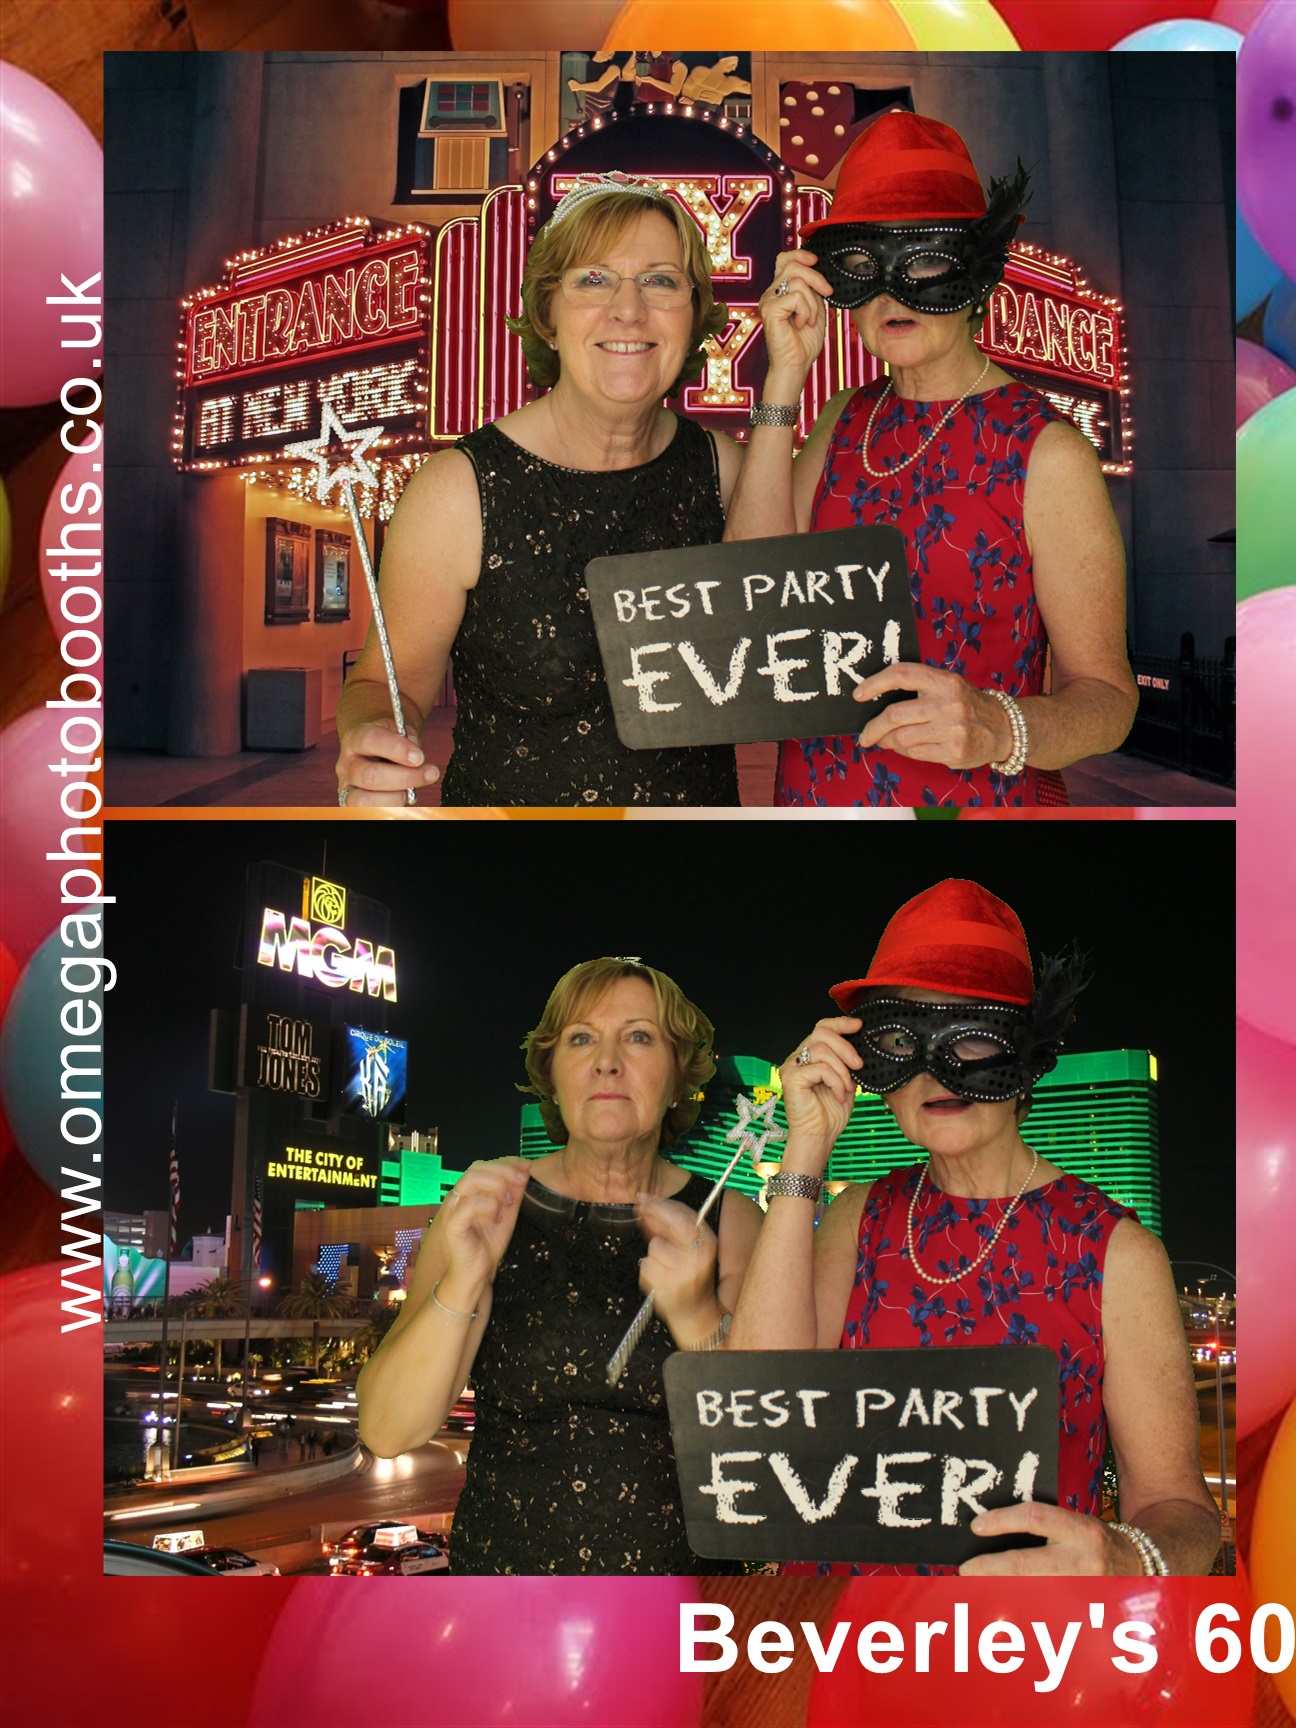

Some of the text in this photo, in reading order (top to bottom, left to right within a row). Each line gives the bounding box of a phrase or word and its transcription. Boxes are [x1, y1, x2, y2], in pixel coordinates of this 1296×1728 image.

[191, 249, 421, 375] ENTRANCE
[974, 281, 1114, 378] RANCE
[613, 560, 891, 623] BEST PARTY
[621, 619, 901, 714] EVER!
[257, 907, 397, 1003] MGM
[266, 1013, 313, 1056] TOM
[350, 1028, 405, 1049] CIRQUE DU SOLEIL
[257, 1052, 321, 1098] JONES
[267, 1162, 378, 1189] ENTERTAINMENT
[286, 1147, 364, 1171] THE CITY OF
[696, 1387, 1039, 1432] BEST PARTY
[698, 1450, 1040, 1528] EVER!
